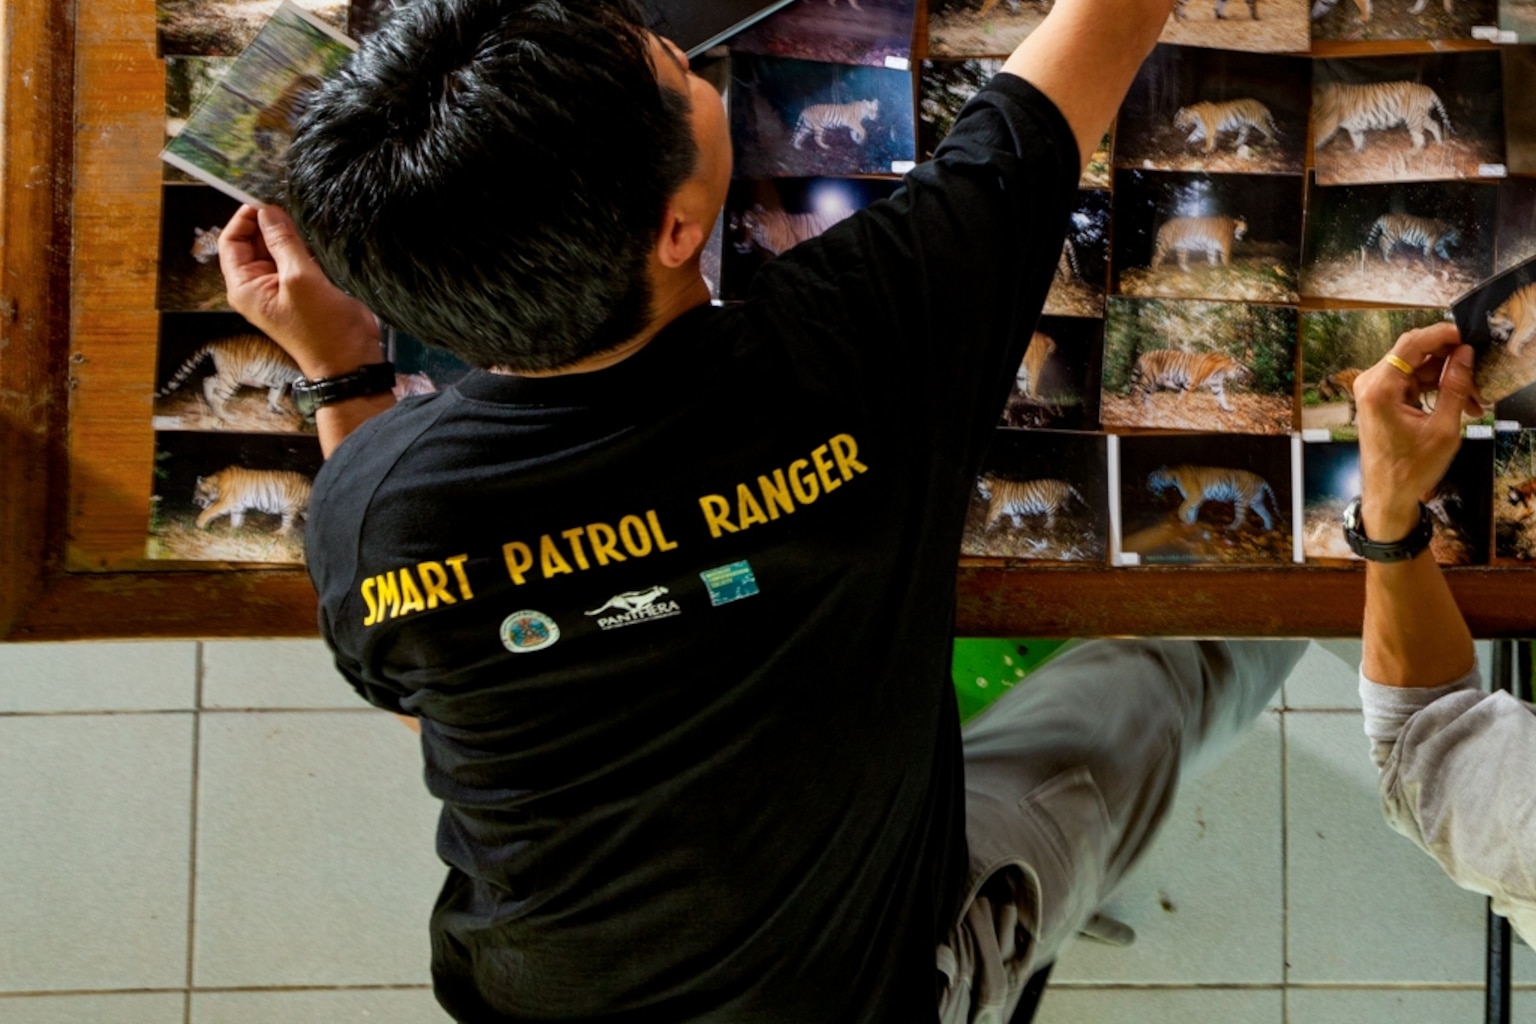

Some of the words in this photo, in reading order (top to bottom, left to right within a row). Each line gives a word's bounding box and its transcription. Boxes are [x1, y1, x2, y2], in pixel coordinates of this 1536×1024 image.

[361, 554, 474, 627] SMART
[502, 510, 678, 585] PATROL
[698, 433, 869, 538] RANGER
[596, 600, 680, 628] PANTHERA
